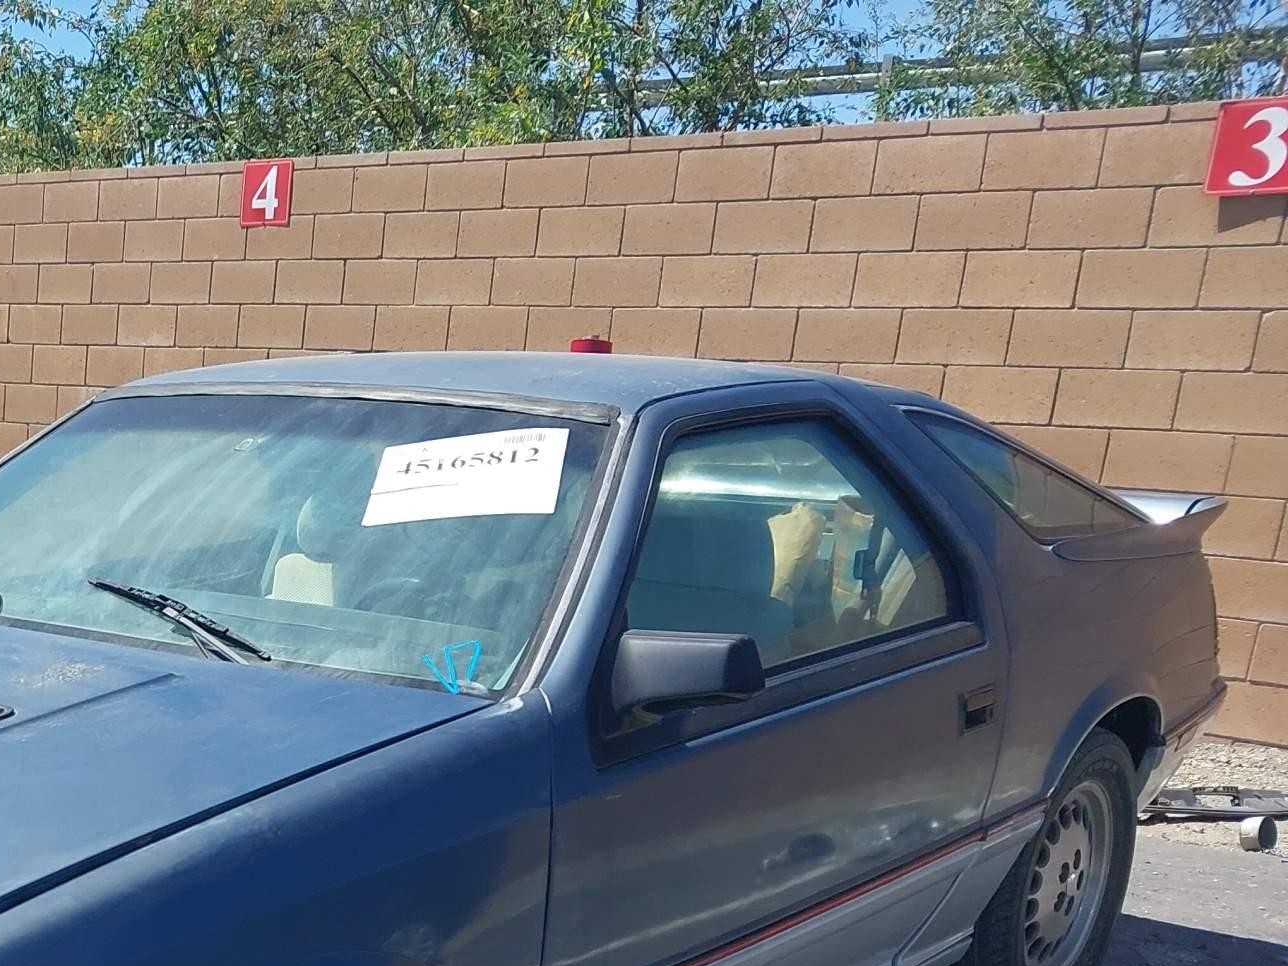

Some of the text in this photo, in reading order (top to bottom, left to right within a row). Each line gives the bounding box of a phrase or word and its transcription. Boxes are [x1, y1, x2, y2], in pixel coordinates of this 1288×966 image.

[1228, 106, 1288, 187] 3
[251, 165, 279, 220] 4
[396, 447, 540, 475] 45165812
